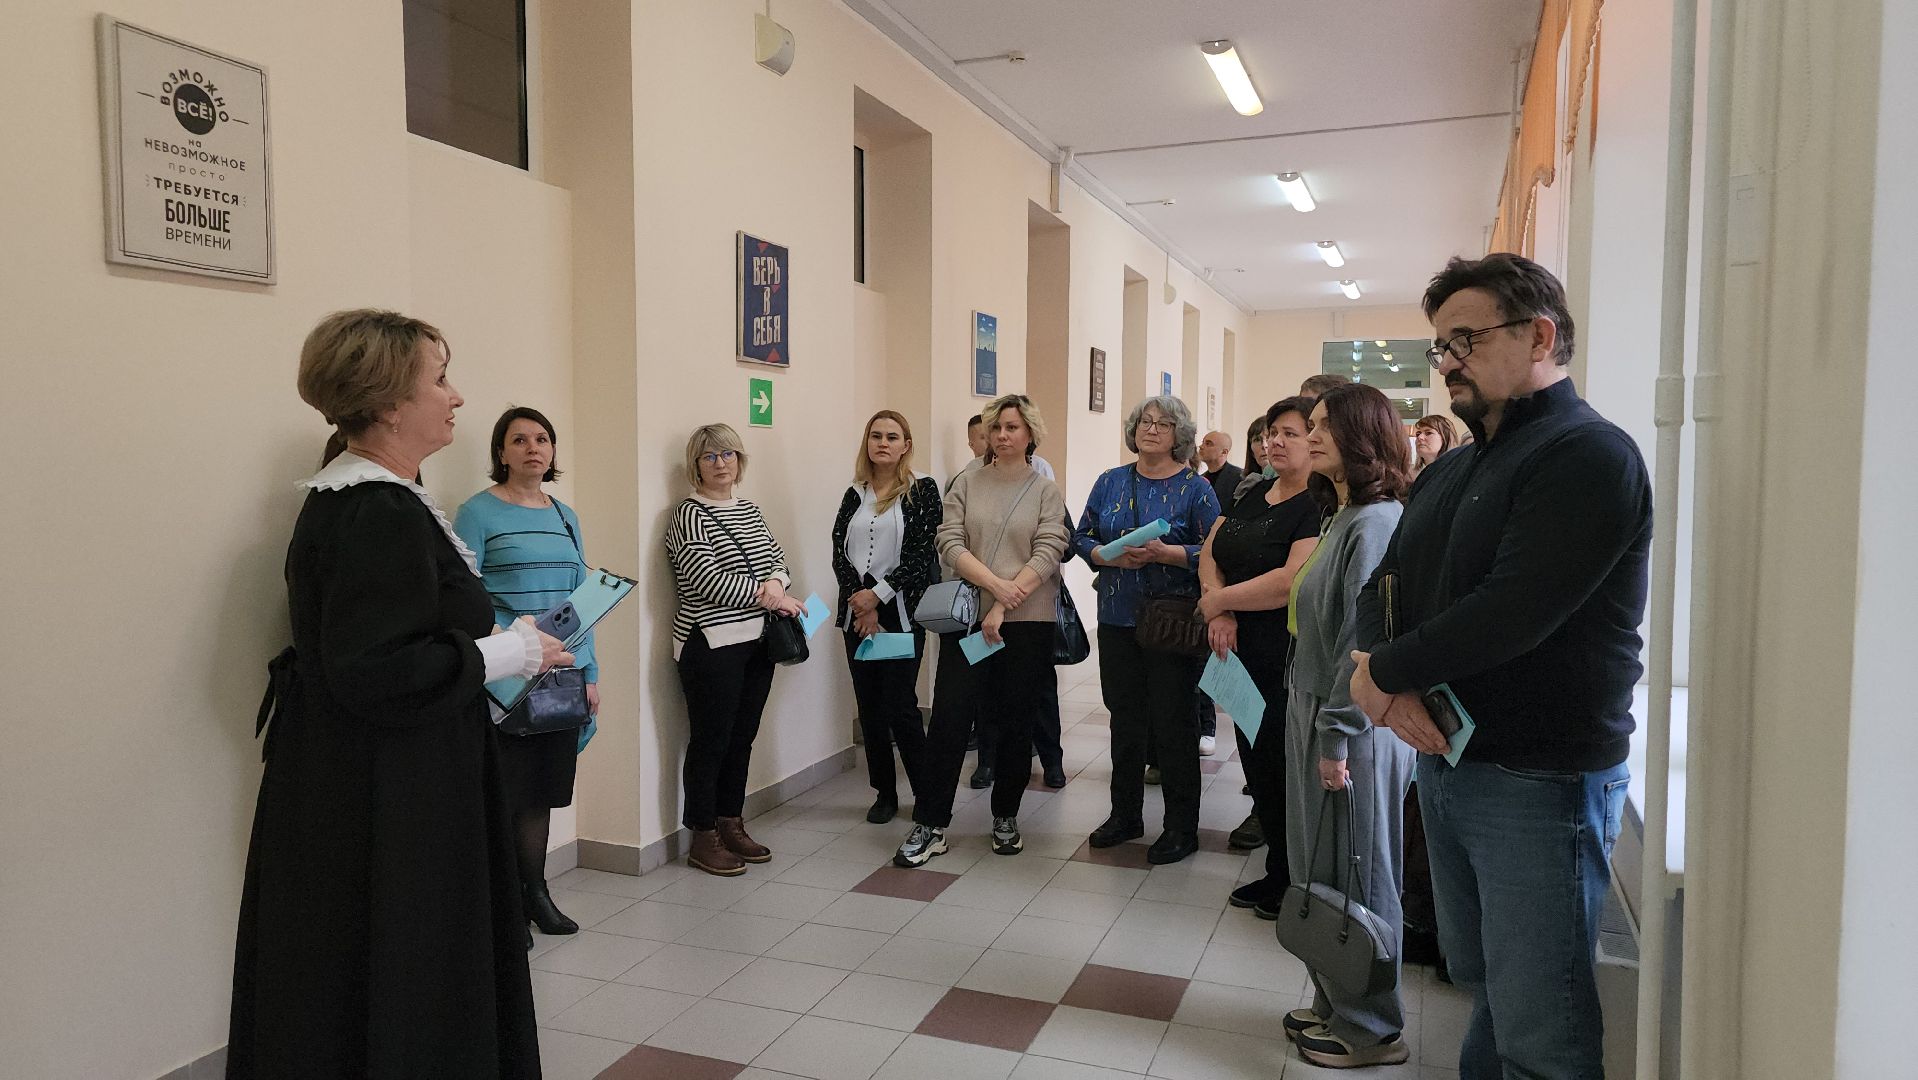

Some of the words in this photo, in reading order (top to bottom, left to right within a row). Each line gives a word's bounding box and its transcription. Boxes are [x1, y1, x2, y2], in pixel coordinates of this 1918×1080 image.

[160, 68, 229, 122] ВОЗМОЖНО
[177, 98, 213, 121] ВСЁ!
[144, 138, 246, 171] НЕВОЗМОЖНОЕ
[188, 139, 202, 149] на
[168, 162, 225, 181] просто
[153, 177, 239, 206] ТРЕБУЕТСЯ
[165, 198, 231, 233] БОЛЬШЕ
[165, 227, 231, 251] ВРЕМЕНИ
[752, 256, 781, 286] ВЕРЬ
[763, 286, 771, 316] В
[753, 315, 781, 346] СЕБЯ
